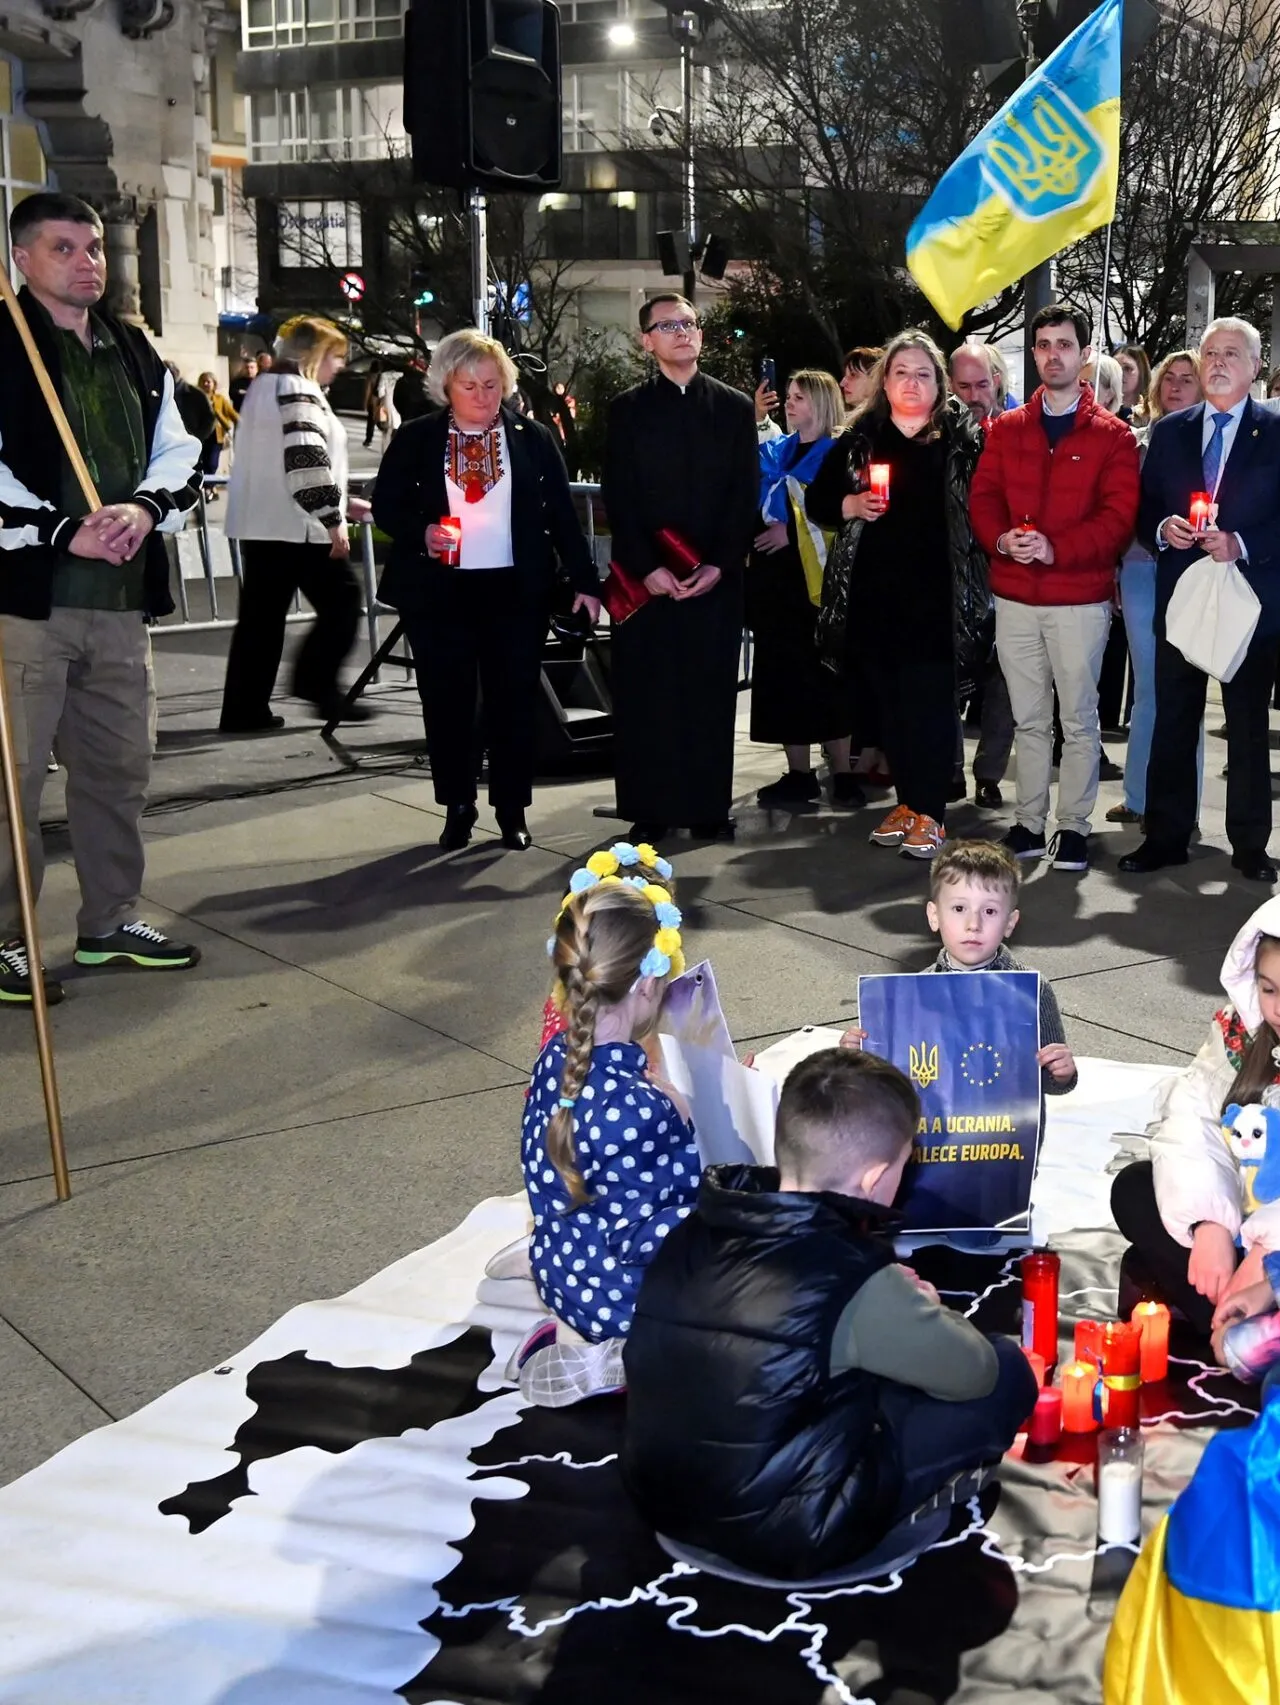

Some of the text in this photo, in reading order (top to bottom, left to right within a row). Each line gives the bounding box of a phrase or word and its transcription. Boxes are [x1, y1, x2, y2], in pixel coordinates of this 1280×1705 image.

[946, 1115, 1016, 1133] UCRANIA.
[912, 1143, 1025, 1164] ALECE EUROPA.
